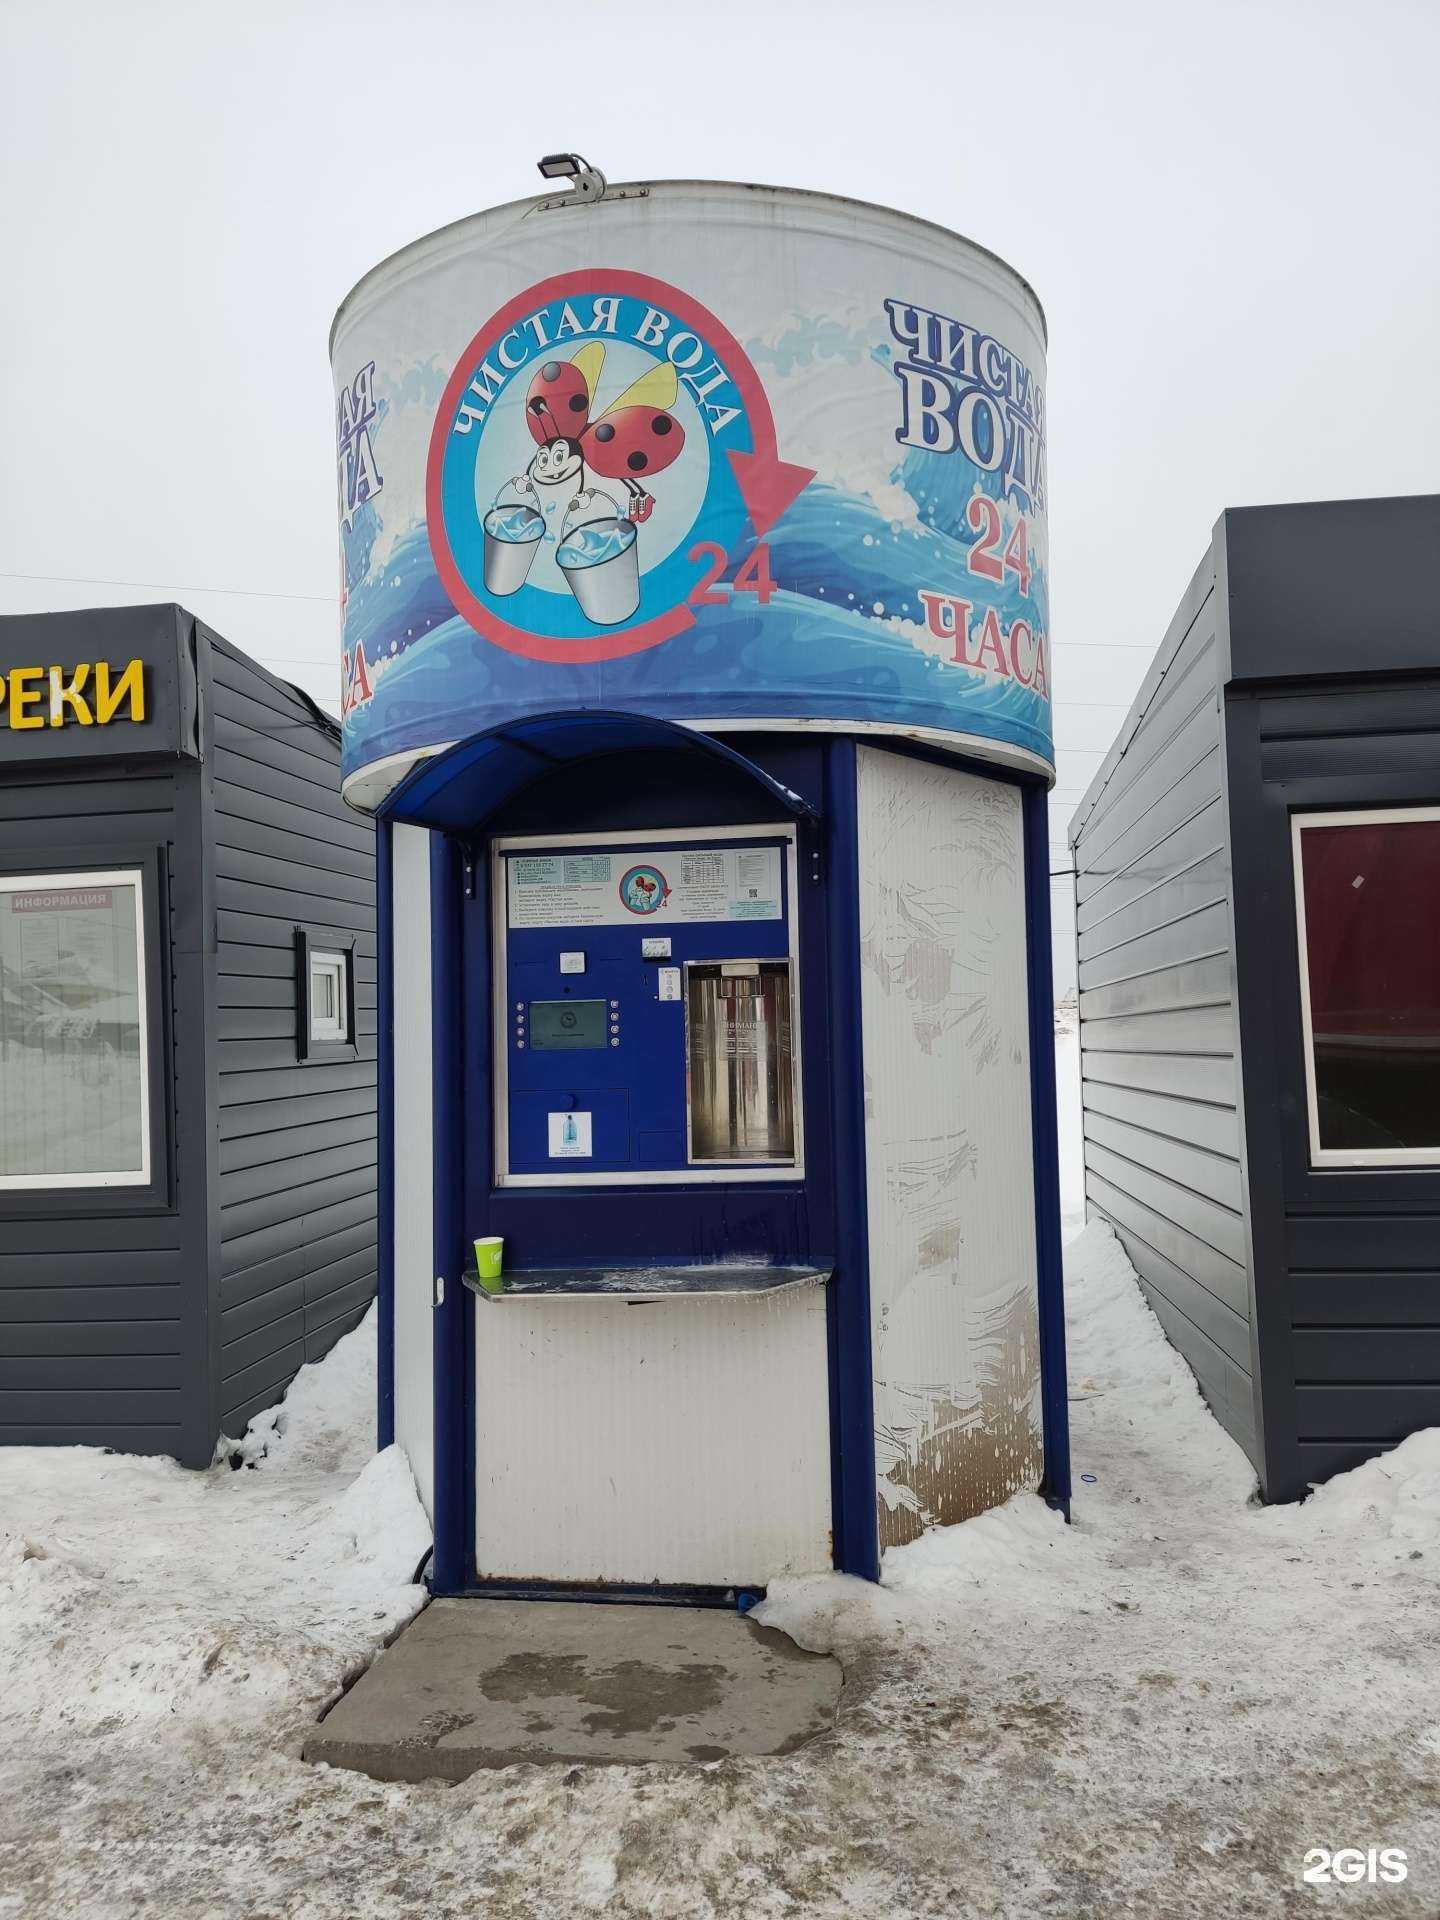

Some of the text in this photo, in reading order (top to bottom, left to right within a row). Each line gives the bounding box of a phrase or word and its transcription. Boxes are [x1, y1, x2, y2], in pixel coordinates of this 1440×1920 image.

[453, 297, 743, 437] ЧИСТАЯ ВОДА
[687, 541, 778, 605] 24
[968, 495, 1031, 597] 24
[919, 591, 1048, 702] ЧАСА
[15, 894, 107, 910] ИНФОРМАЦИЯ
